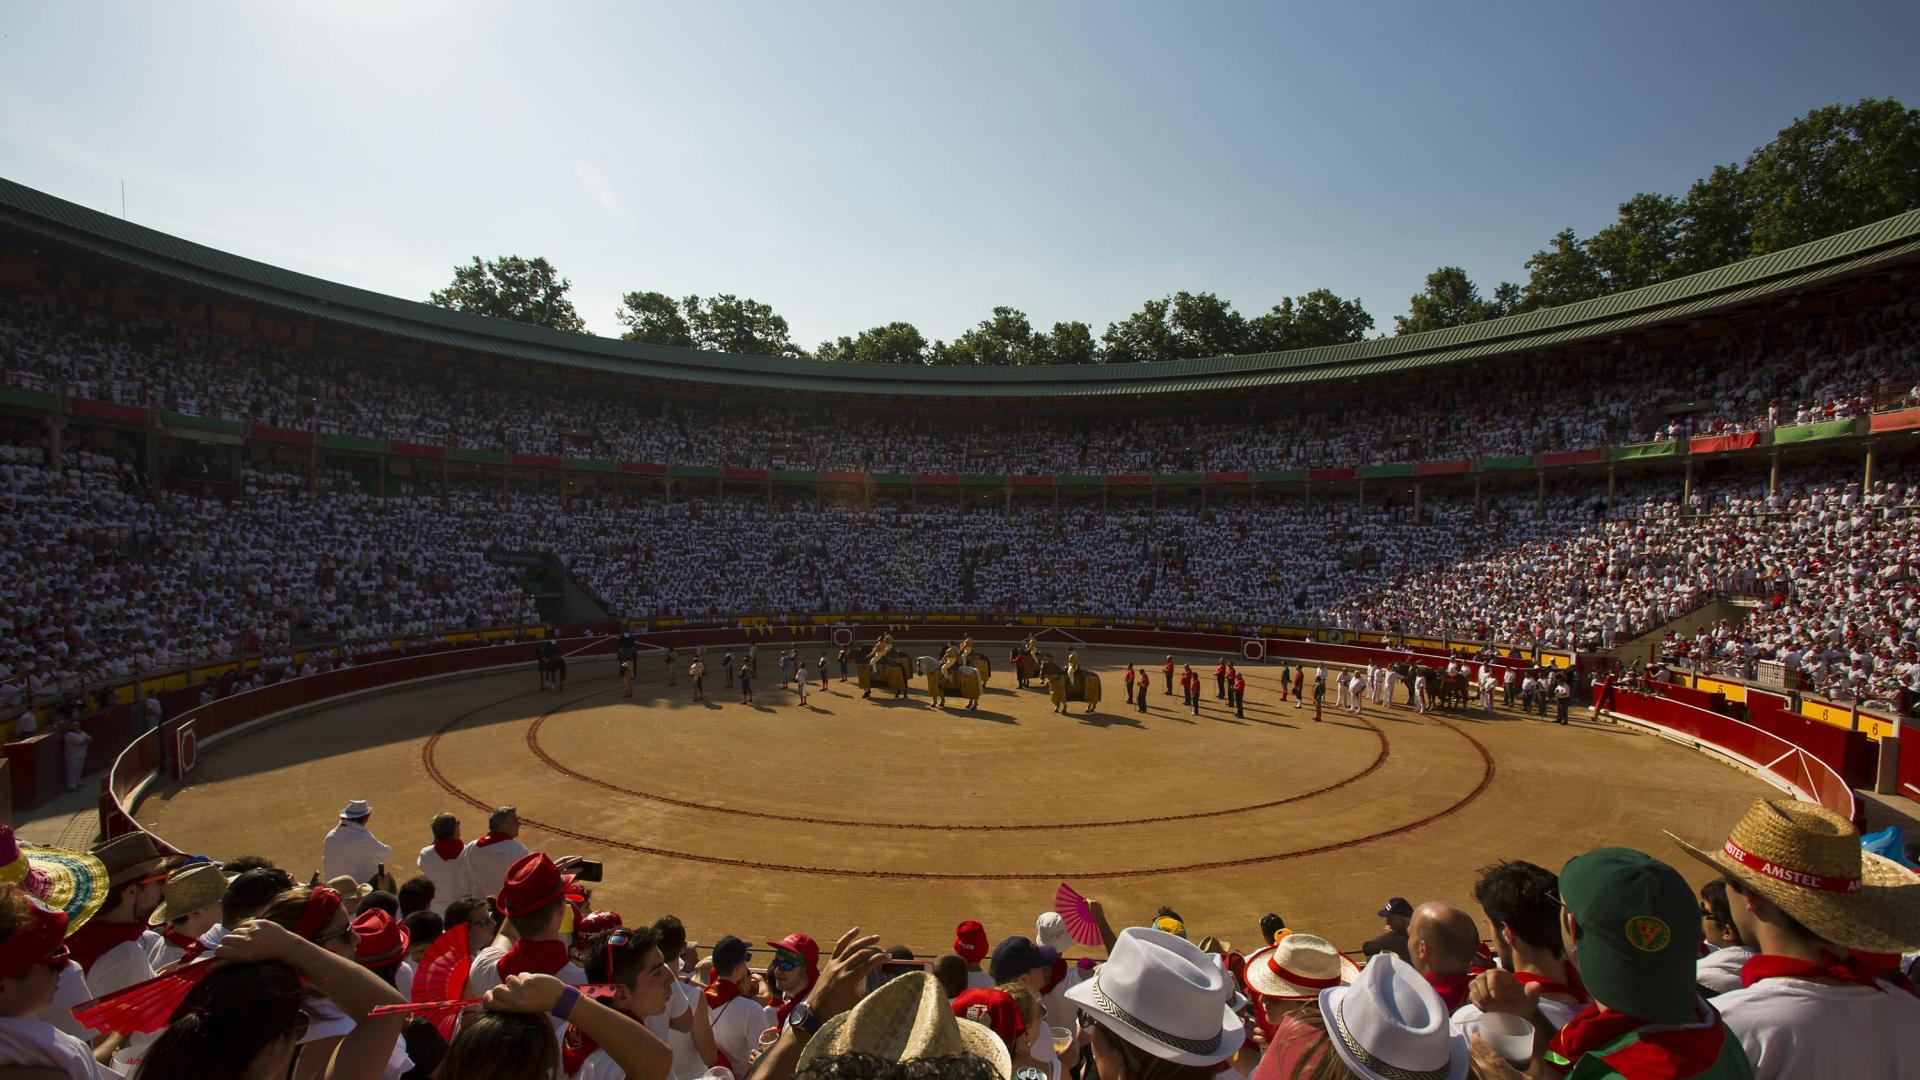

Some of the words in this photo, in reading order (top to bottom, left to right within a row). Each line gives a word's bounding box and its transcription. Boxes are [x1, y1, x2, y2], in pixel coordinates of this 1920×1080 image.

[1822, 708, 1829, 721] 6
[1872, 722, 1879, 736] 6
[1761, 862, 1821, 888] AMSTEL
